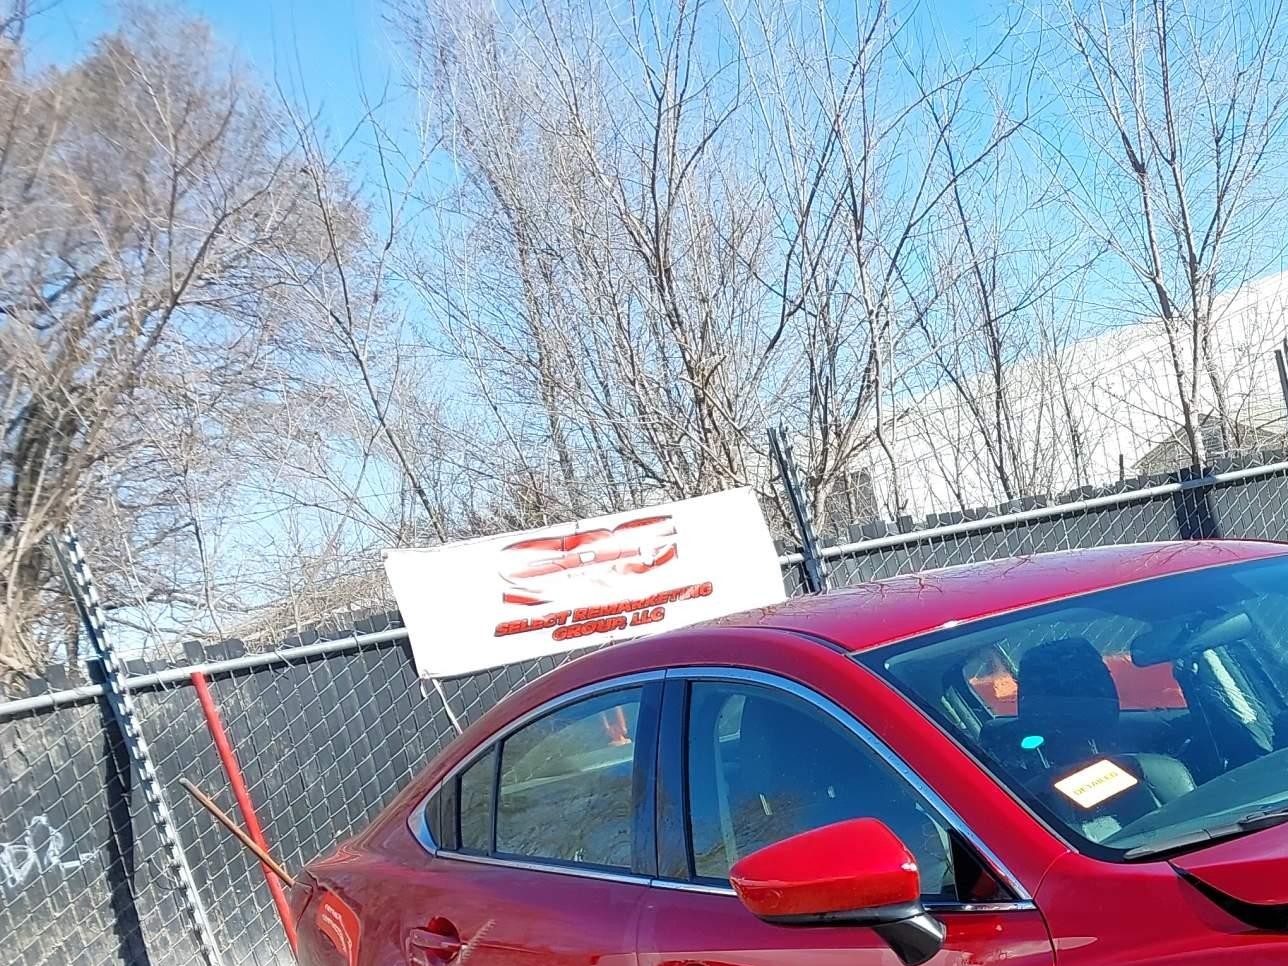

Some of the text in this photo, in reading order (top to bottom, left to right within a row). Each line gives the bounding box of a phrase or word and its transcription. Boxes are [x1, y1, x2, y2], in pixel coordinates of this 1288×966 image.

[494, 582, 714, 637] SELECT REMARKETING
[630, 607, 666, 626] LLC
